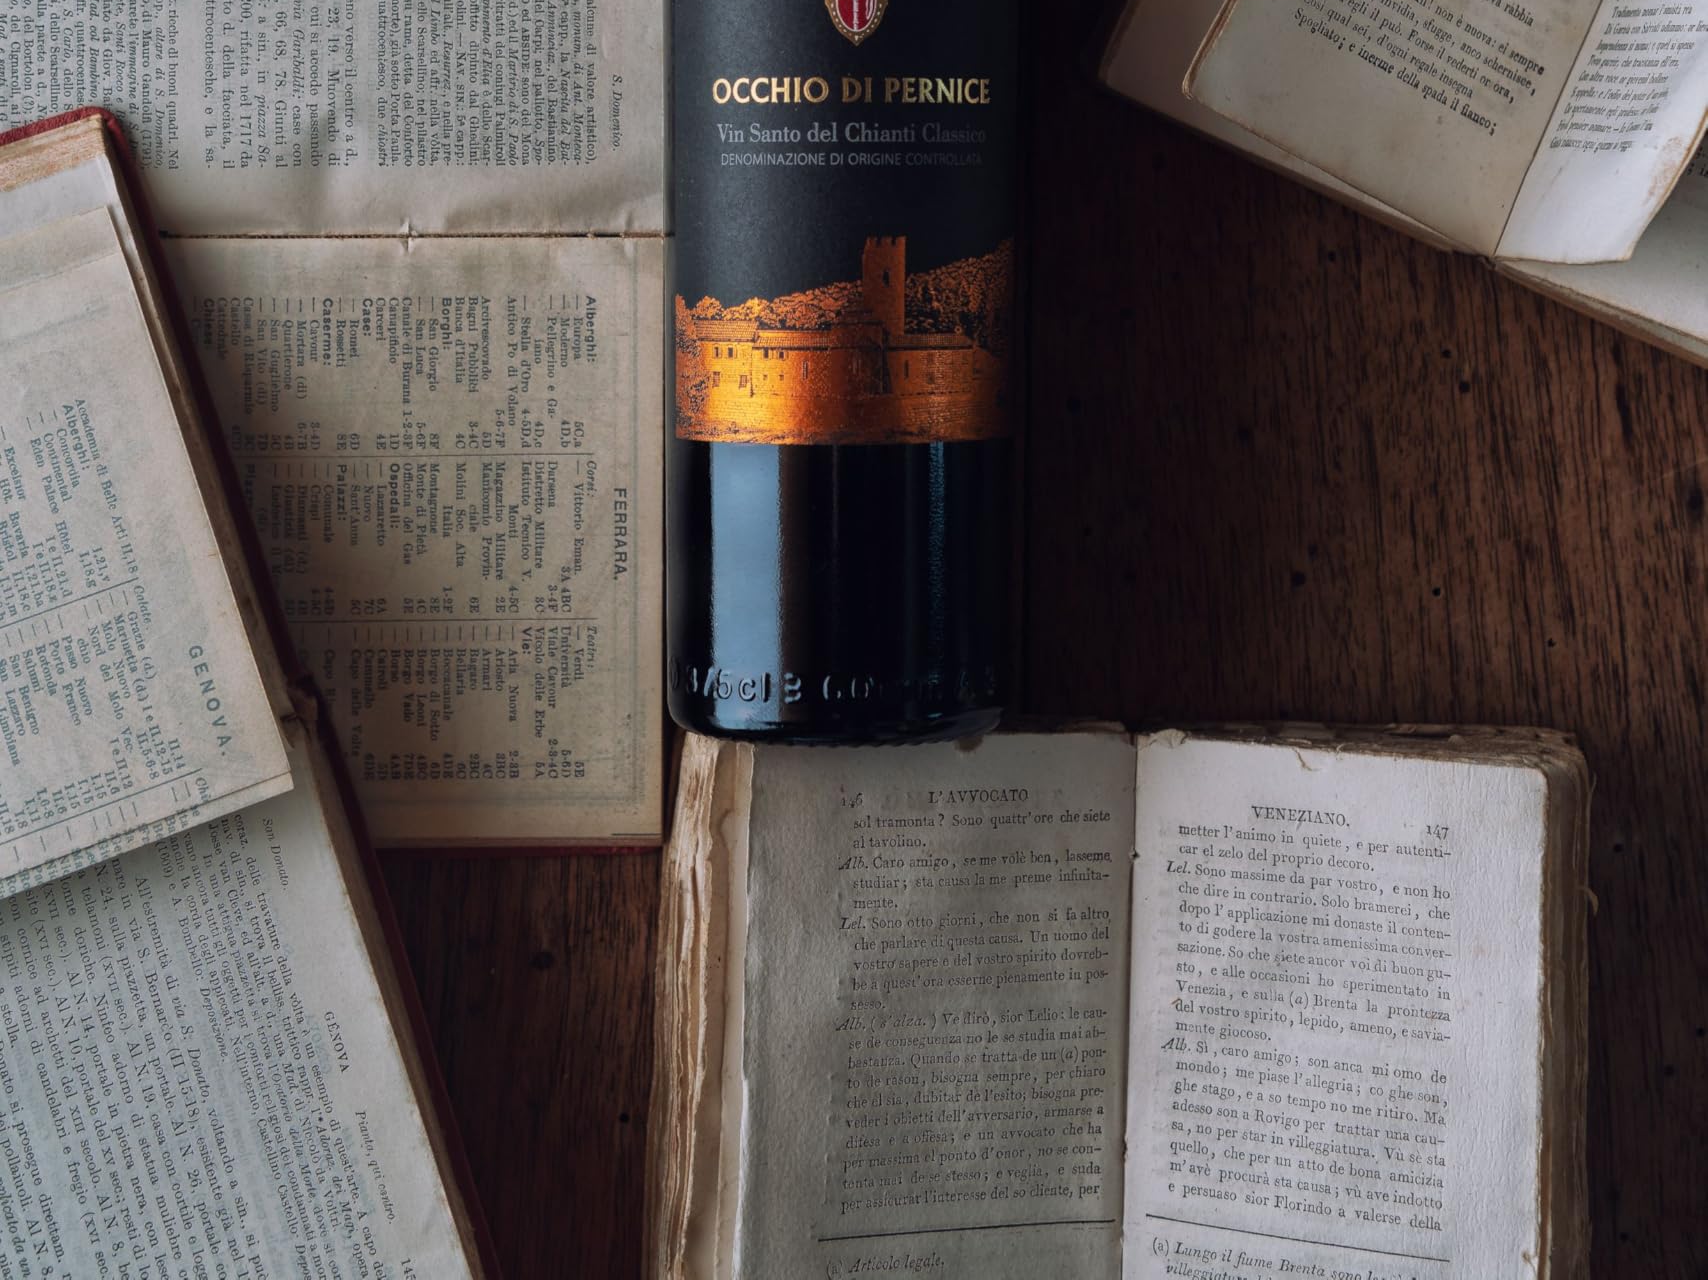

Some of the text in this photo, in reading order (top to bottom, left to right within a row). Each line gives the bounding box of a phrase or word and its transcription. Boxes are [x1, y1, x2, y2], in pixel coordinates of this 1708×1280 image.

[612, 74, 622, 86] S.
[712, 77, 990, 104] OCCHIO DI PERNICE
[612, 90, 622, 151] Domenico.
[717, 122, 985, 143] Vin Santo del Chianti Classico
[721, 152, 825, 166] DENOMINAZIONE
[830, 152, 844, 166] DI
[848, 152, 902, 166] ORIGINE
[440, 298, 452, 350] Borghi:
[560, 318, 570, 367] Moderno
[572, 317, 583, 360] Europa
[584, 296, 596, 362] Alberghi:
[482, 296, 491, 448] Arcivescovado 5D
[55, 428, 81, 488] Concordia
[61, 405, 90, 472] Alberghi:
[42, 431, 72, 503] Continental
[574, 484, 584, 574] Vittorio Eman.
[614, 488, 627, 580] FERRARA.
[189, 645, 232, 756] GENOVA.
[853, 832, 926, 849] al tavolino.
[1251, 805, 1449, 840] VENEZIANO. 147
[1179, 844, 1374, 871] car el zelo del proprio decoro.
[1176, 1022, 1271, 1041] mente giocoso.
[1169, 1183, 1442, 1231] e persuaso sior Florindo a valerse della
[848, 1256, 900, 1273] Articolo
